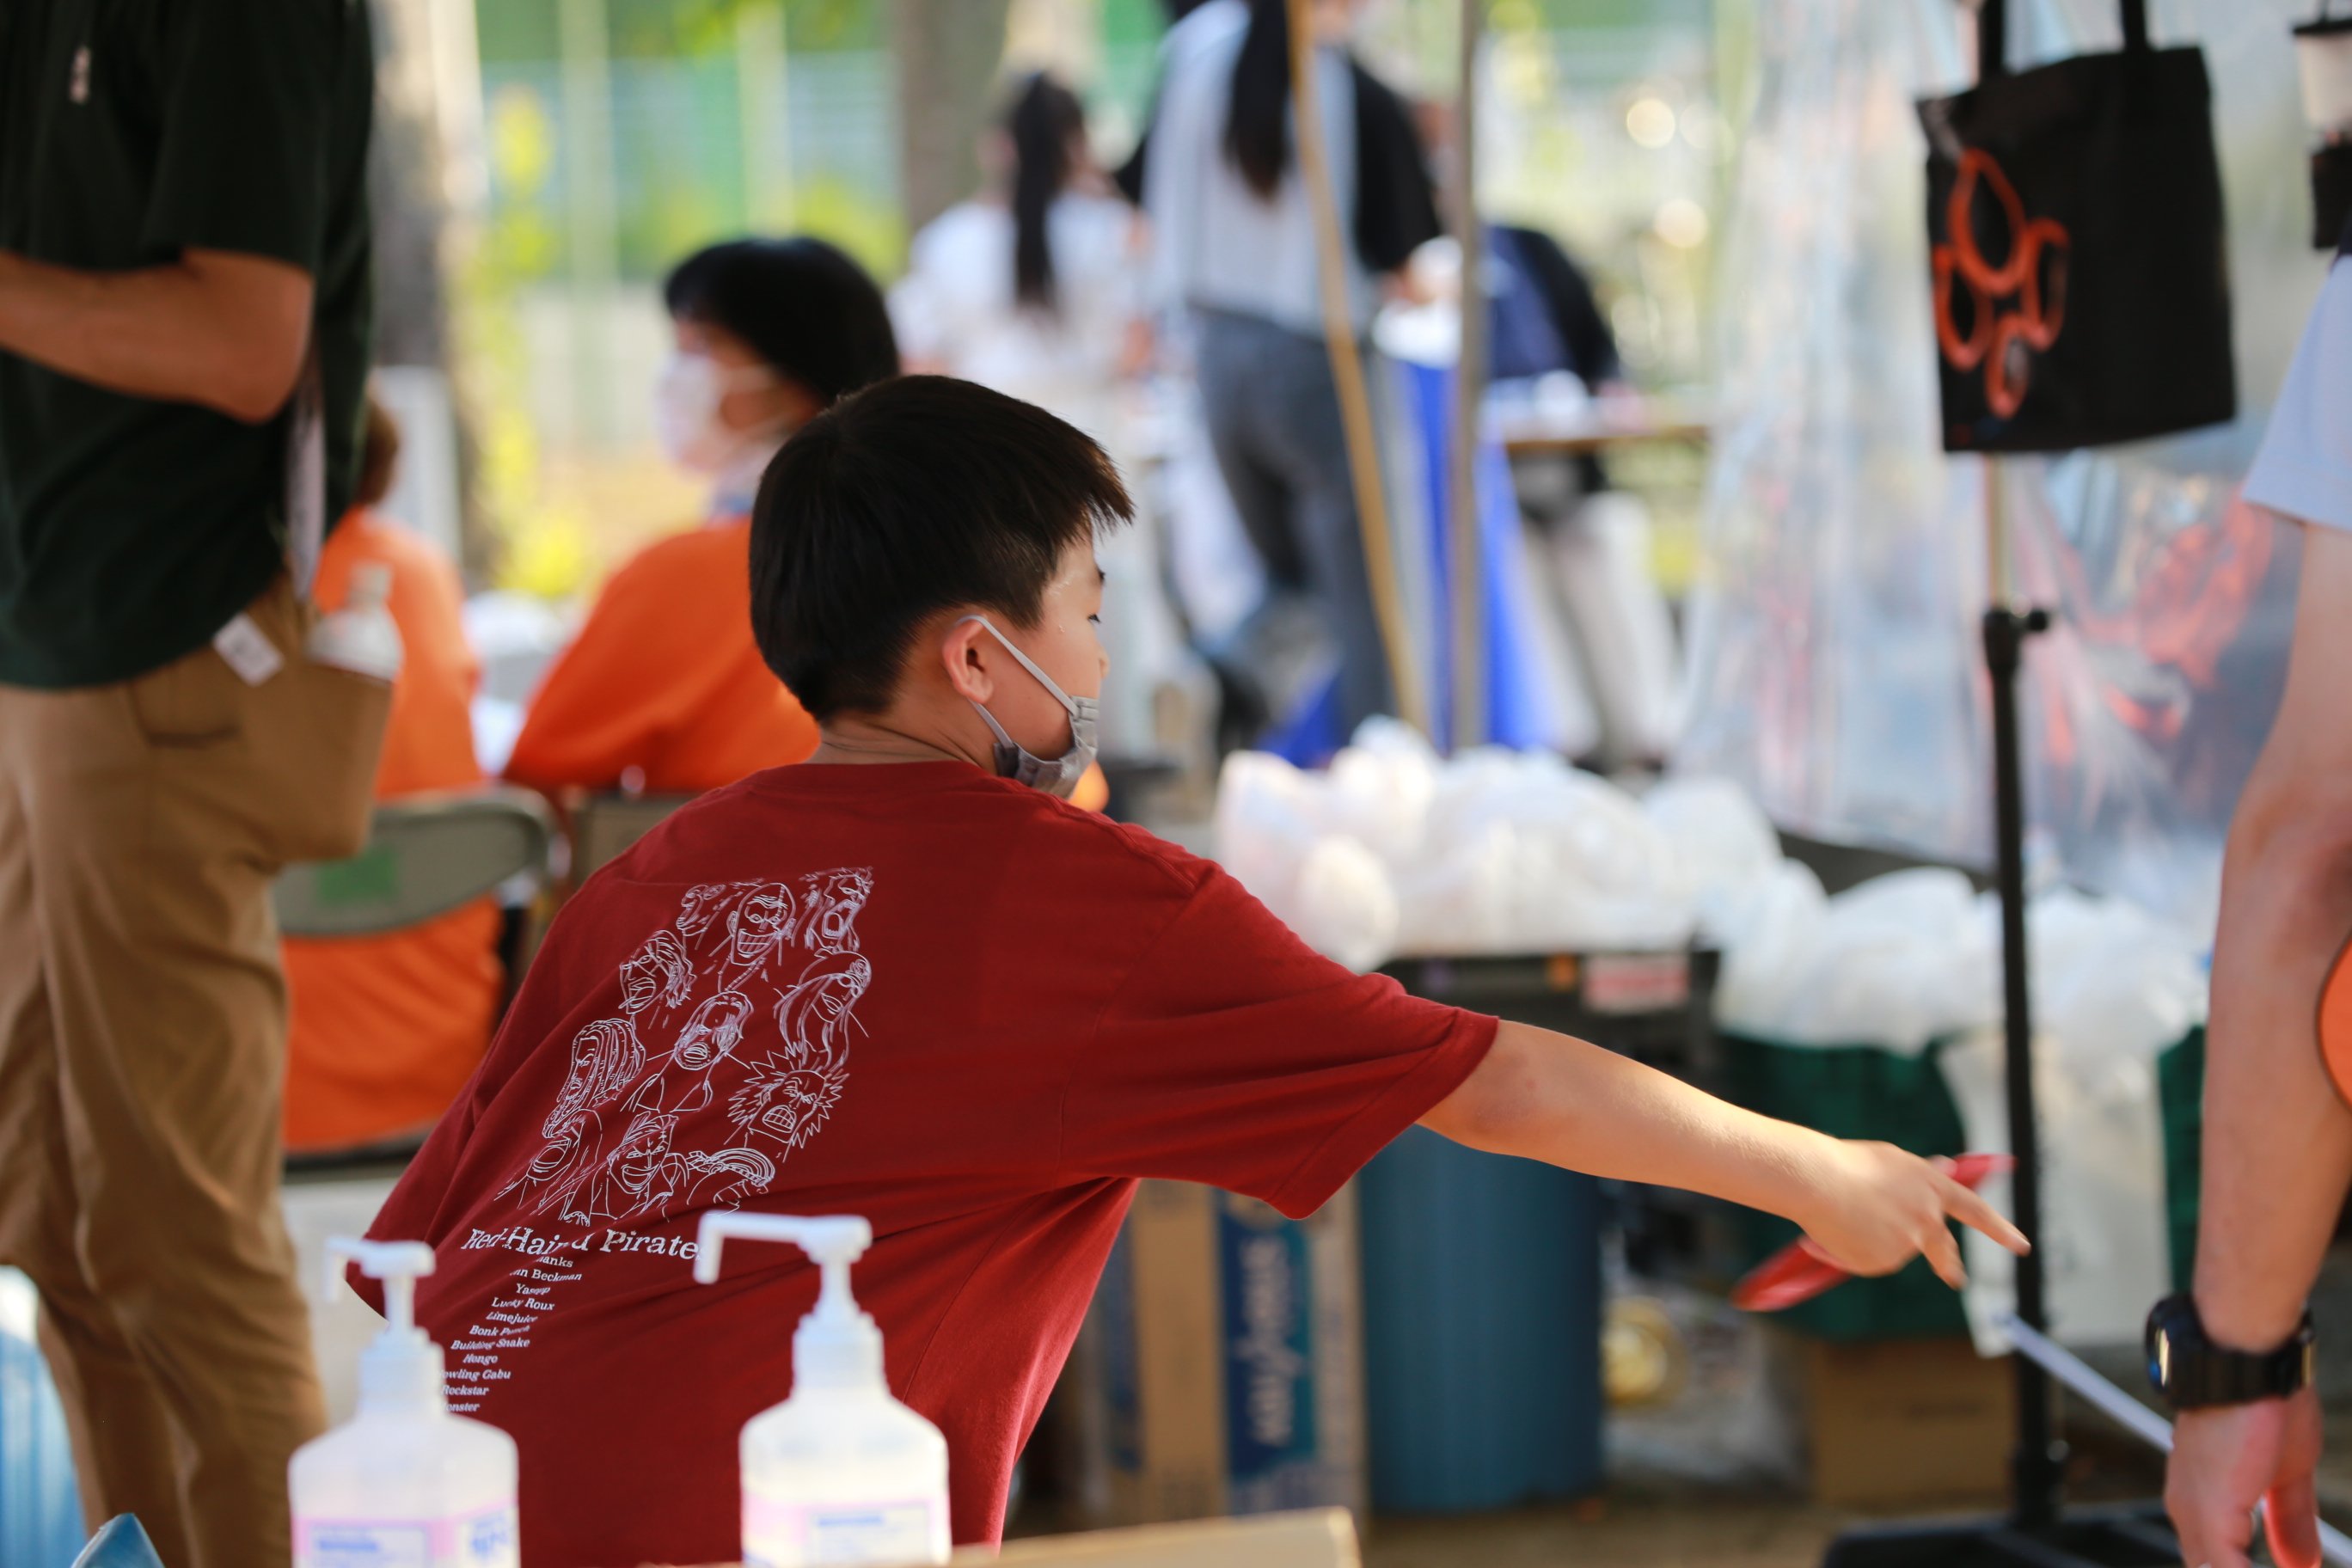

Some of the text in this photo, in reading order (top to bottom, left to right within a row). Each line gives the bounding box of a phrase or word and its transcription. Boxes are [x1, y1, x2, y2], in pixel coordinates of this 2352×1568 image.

[461, 1226, 701, 1261] Red-Haird Pirate
[531, 1268, 582, 1282] Beckman
[516, 1283, 550, 1295] Yasopp
[491, 1296, 554, 1311] Lucky Roux
[486, 1311, 538, 1325] Limejuice
[469, 1325, 499, 1337] Bonk
[450, 1337, 530, 1351] Building Snake
[462, 1353, 498, 1366] Hongo
[442, 1369, 511, 1382] owling Gabu
[446, 1402, 481, 1412] onster
